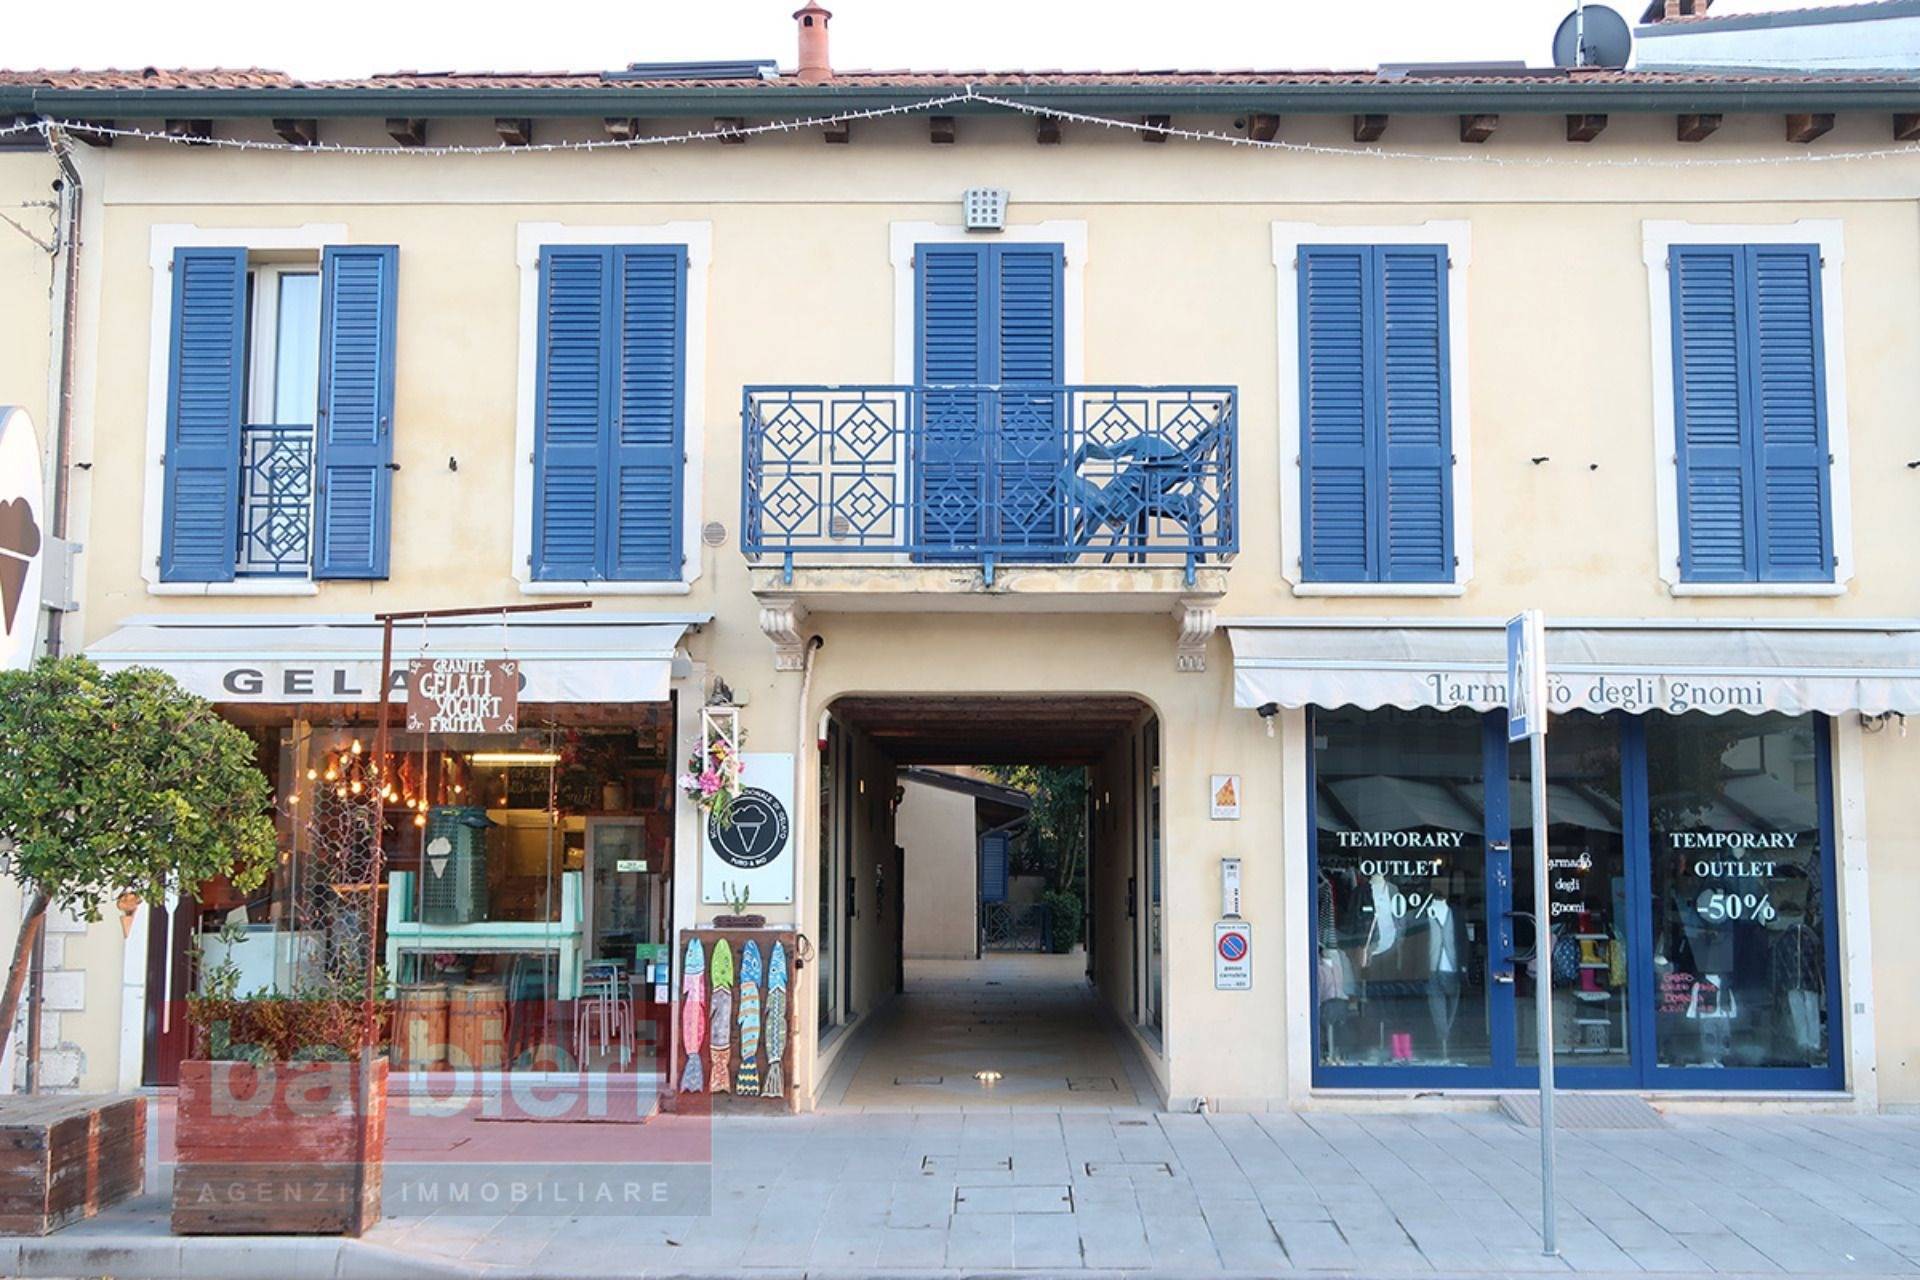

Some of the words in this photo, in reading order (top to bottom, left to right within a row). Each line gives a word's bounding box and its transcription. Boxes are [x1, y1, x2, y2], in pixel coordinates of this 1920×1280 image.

[432, 658, 486, 674] GRANITE
[419, 671, 493, 699] GELATI
[1426, 673, 1572, 708] L'armio
[1588, 676, 1654, 710] degli
[1669, 681, 1763, 713] gnomi
[435, 696, 503, 719] YOGURT
[429, 716, 486, 733] FRUTTA
[1336, 831, 1464, 847] TEMPORARY
[1669, 832, 1798, 849] TEMPORARY
[1360, 859, 1441, 876] OUTLET
[1694, 860, 1776, 877] OUTLET
[1554, 878, 1580, 893] degli
[1551, 901, 1585, 917] gnomi
[1696, 893, 1776, 921] -50%
